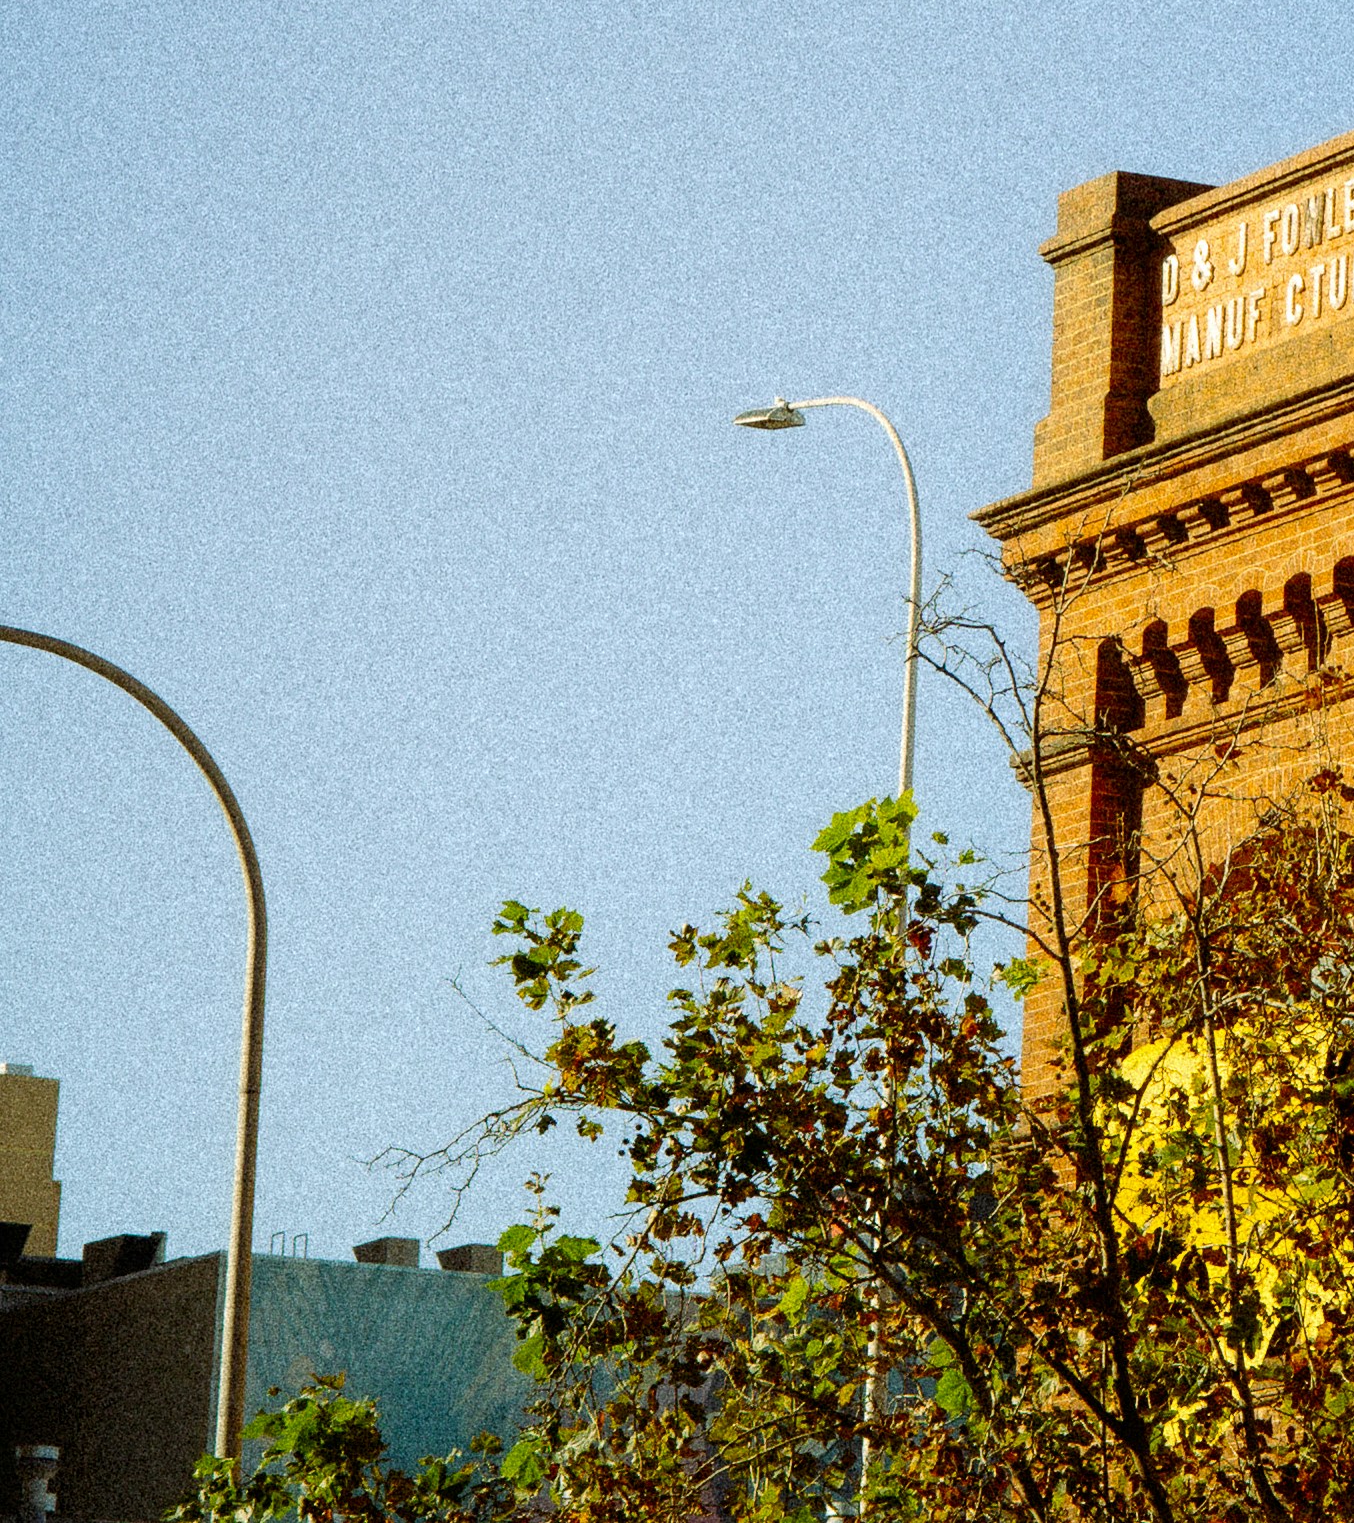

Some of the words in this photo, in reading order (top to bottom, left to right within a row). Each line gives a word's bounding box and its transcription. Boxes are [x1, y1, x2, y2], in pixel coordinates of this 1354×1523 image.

[1161, 253, 1180, 307] D
[1191, 238, 1214, 292] &
[1228, 222, 1249, 277] J
